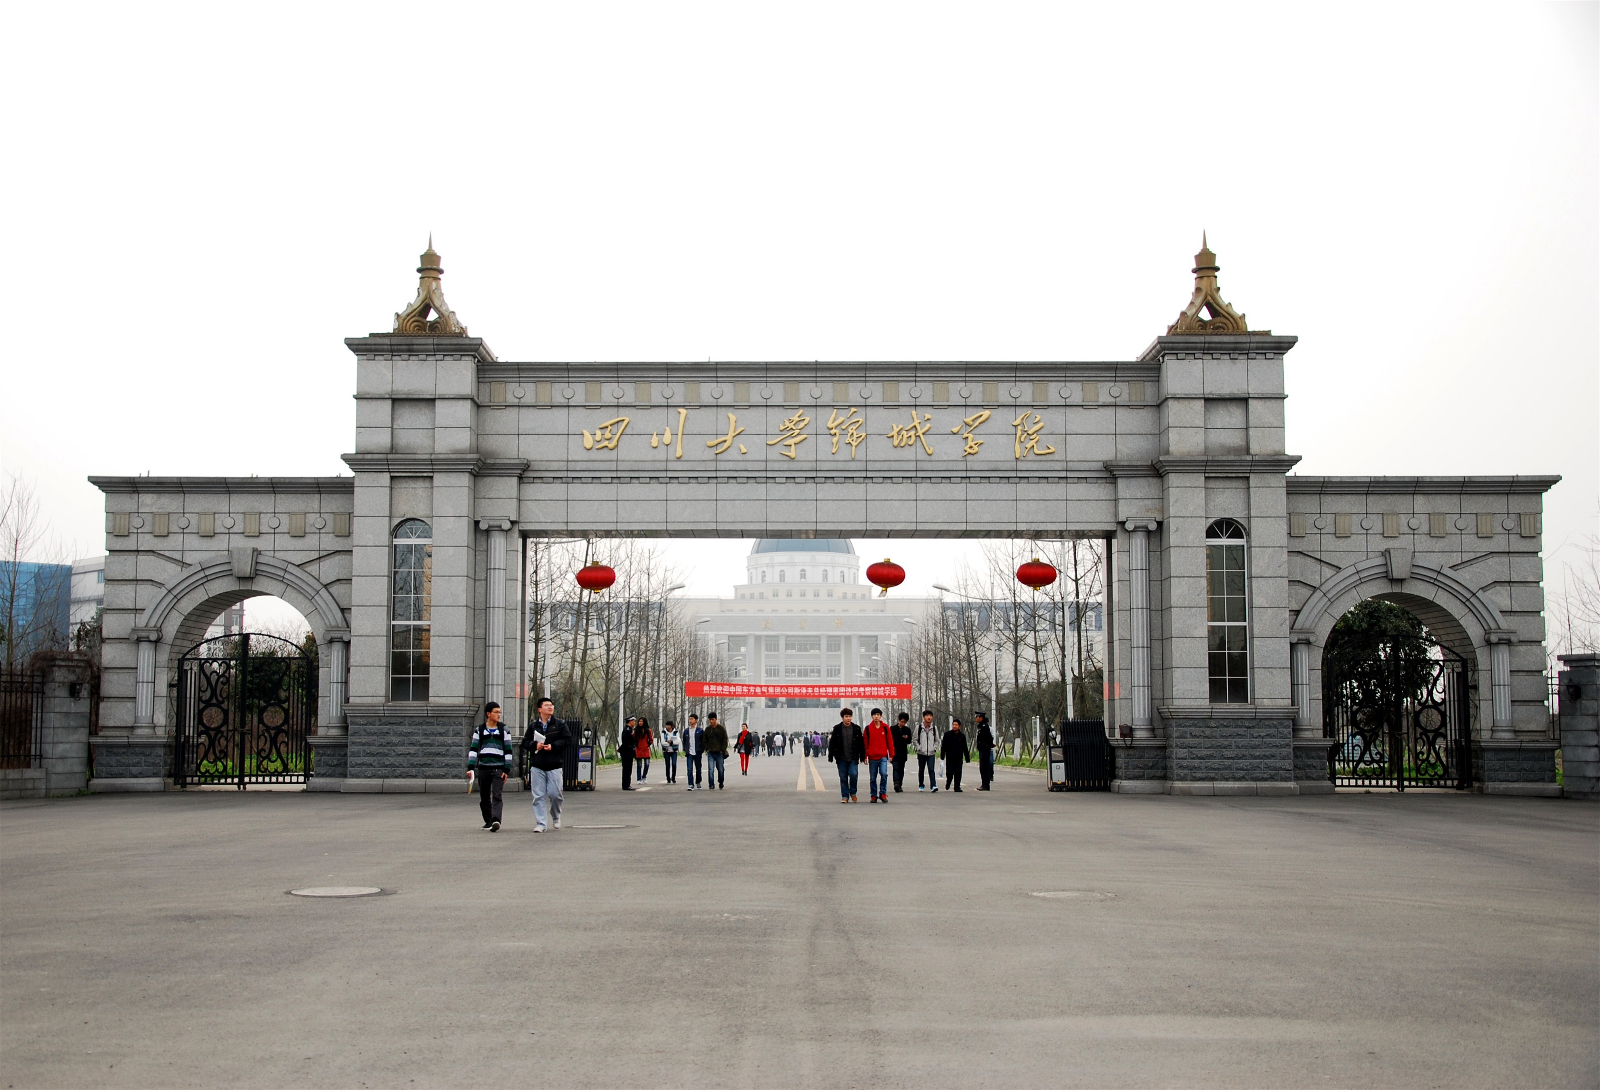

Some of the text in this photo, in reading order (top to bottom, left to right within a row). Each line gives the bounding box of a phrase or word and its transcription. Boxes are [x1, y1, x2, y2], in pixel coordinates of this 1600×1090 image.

[582, 407, 1056, 459] 四川大学锦城学院
